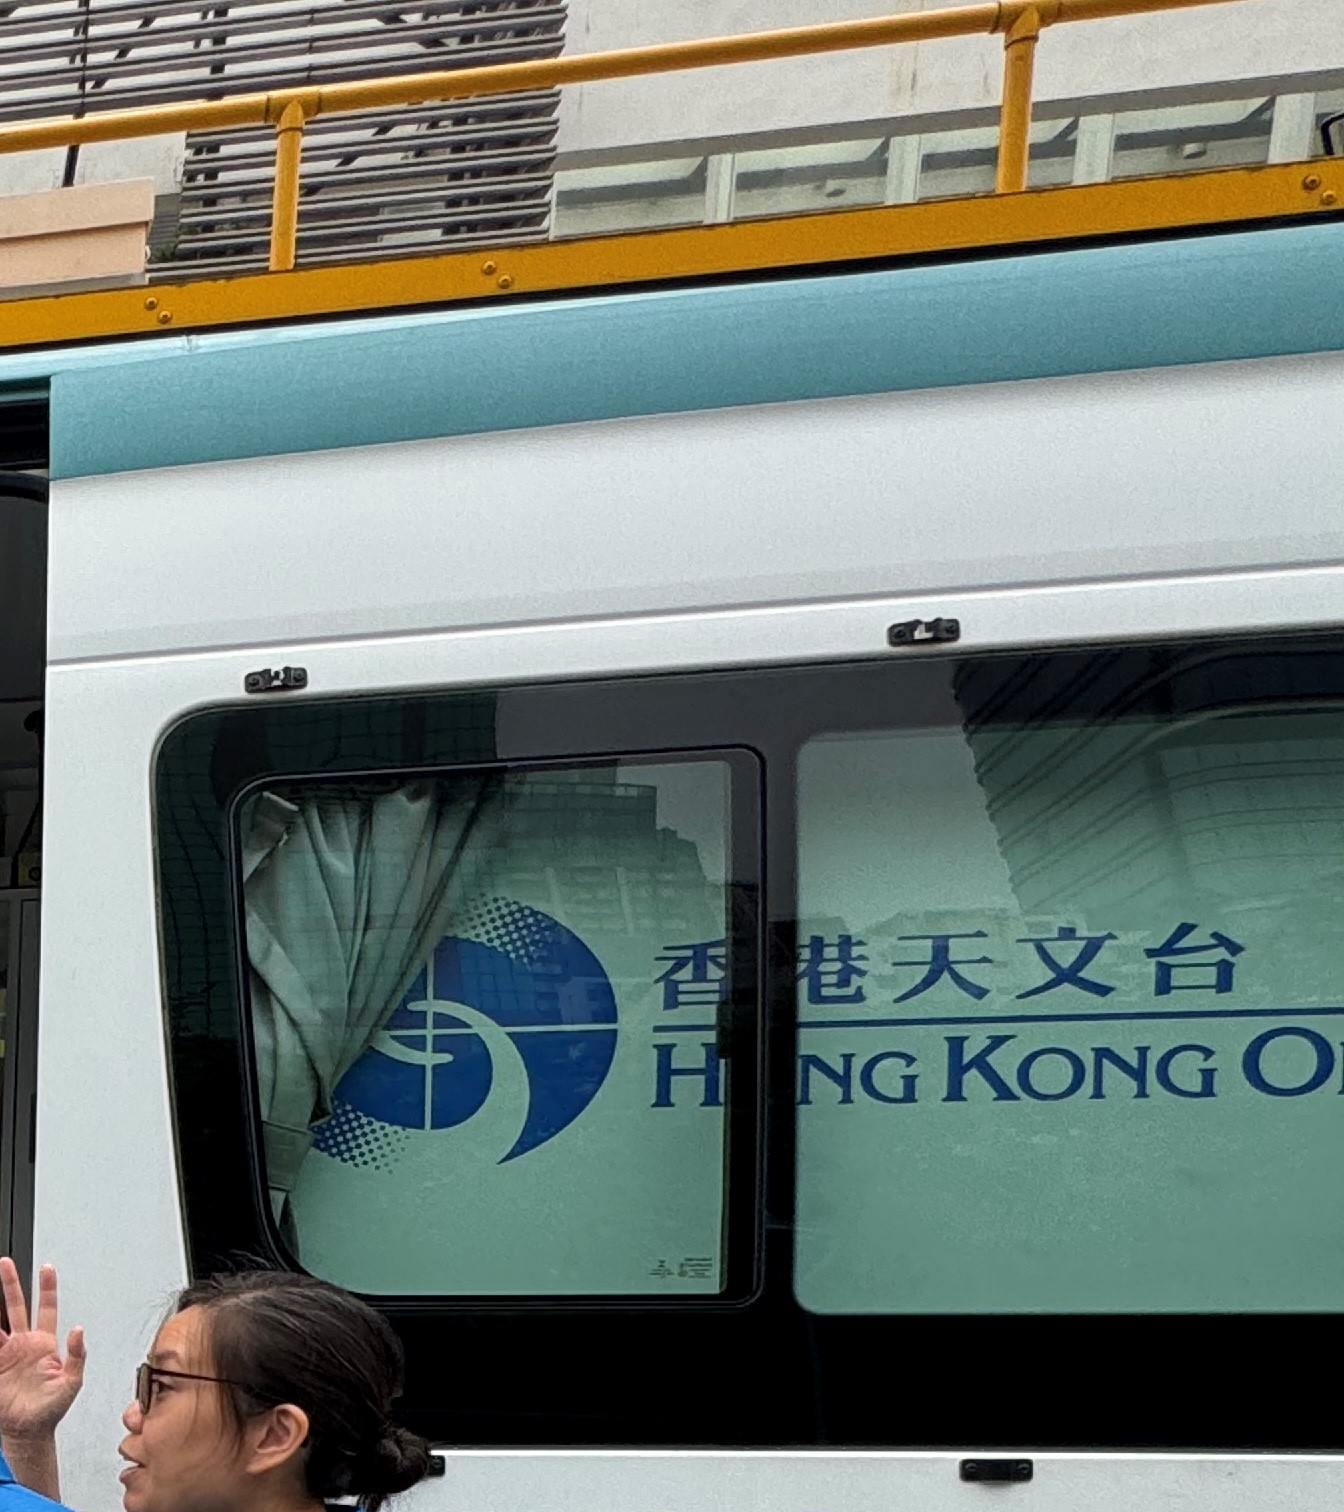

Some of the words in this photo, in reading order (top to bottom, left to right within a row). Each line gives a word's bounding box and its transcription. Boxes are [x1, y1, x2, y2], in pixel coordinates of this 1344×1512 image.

[652, 922, 1246, 1011] 香港天文台
[651, 1042, 919, 1107] HNG
[942, 1033, 1219, 1103] KONG
[1242, 1026, 1344, 1097] O
